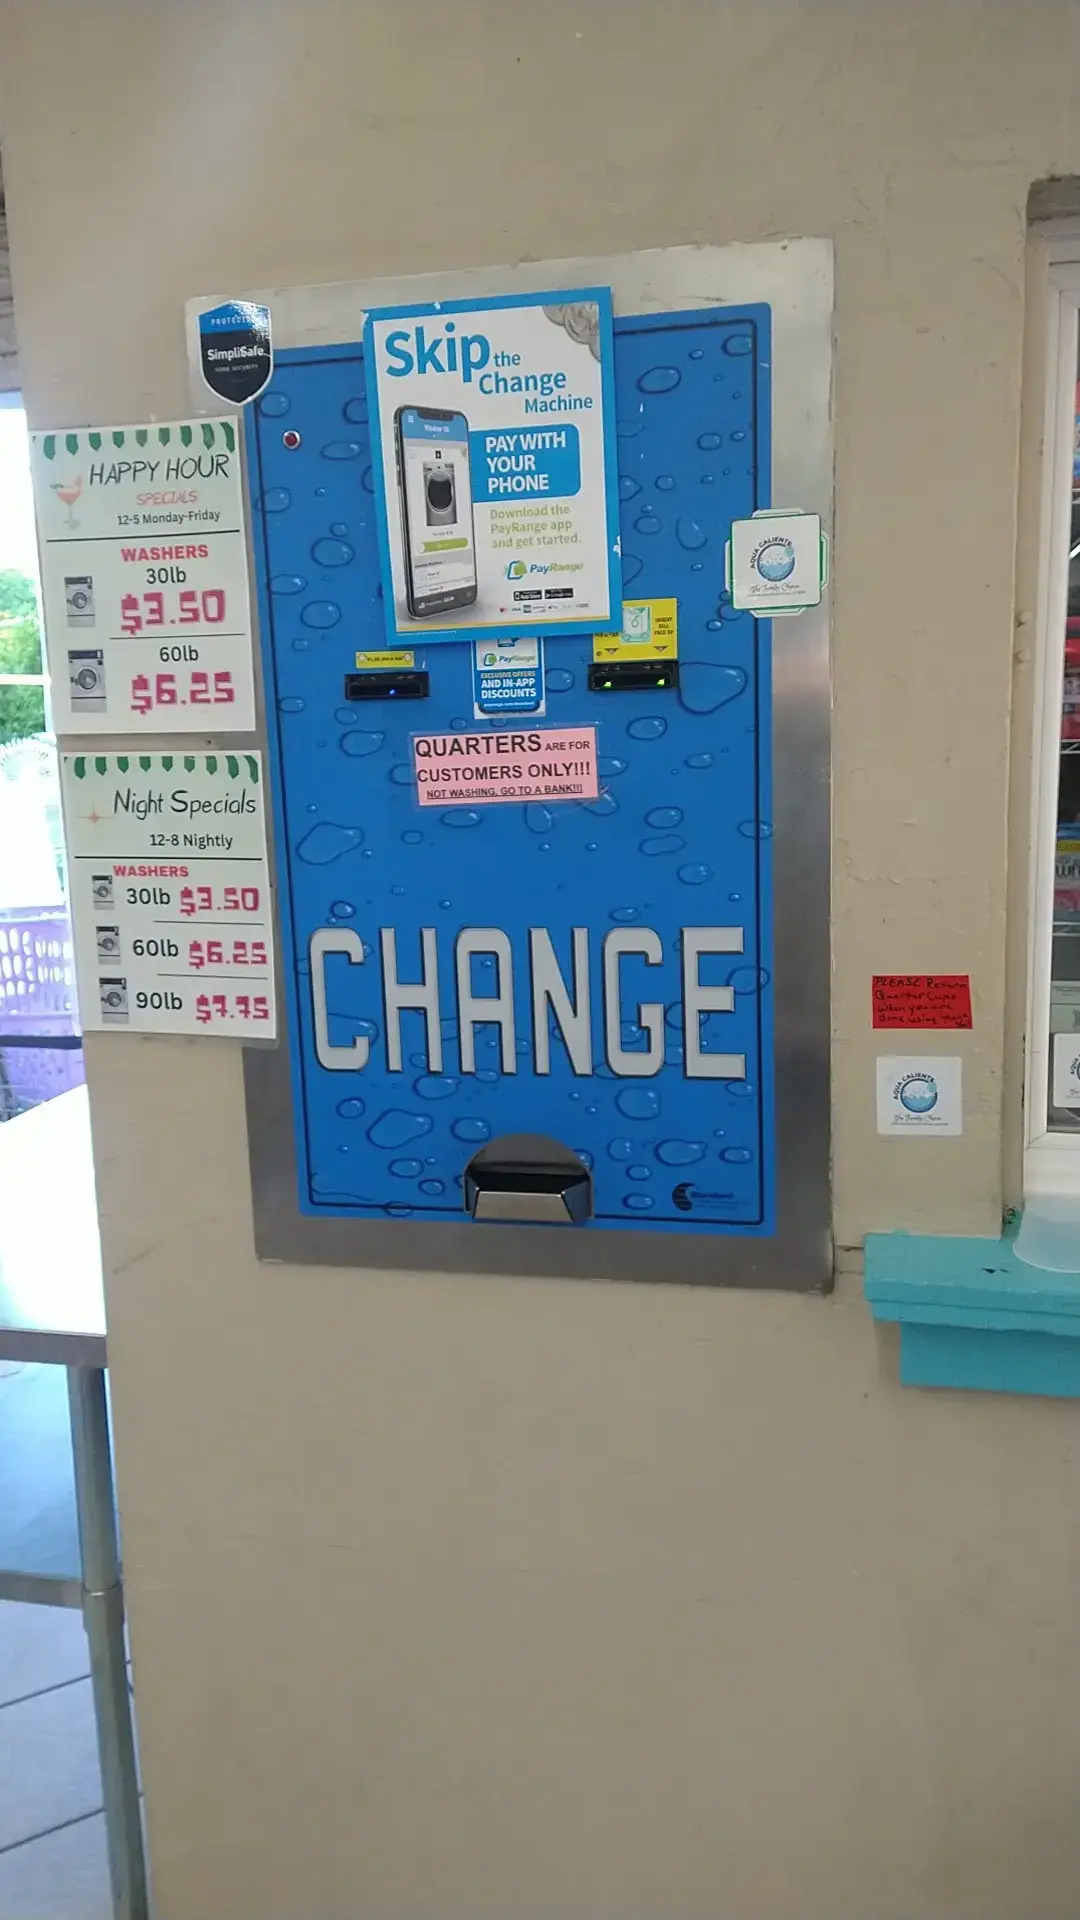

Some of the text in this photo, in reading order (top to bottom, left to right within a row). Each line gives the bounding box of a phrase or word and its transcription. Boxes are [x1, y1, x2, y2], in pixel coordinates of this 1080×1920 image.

[207, 345, 264, 361] SimpliSafe
[384, 322, 521, 383] Skip the
[479, 372, 566, 397] Change
[524, 395, 593, 414] Machine
[485, 431, 566, 453] PAY WITH
[89, 454, 230, 486] HAPPY HOUR
[485, 455, 536, 474] YOUR
[488, 474, 549, 494] PHONE
[136, 490, 198, 506] SPECIALS
[117, 510, 220, 525] 12-5 Monday-Friday
[490, 504, 570, 520] Download the
[490, 520, 572, 535] PayRange app
[492, 532, 582, 550] and get started.
[121, 544, 209, 562] WASHERS
[749, 536, 793, 569] AQUA CALIENTE
[146, 566, 187, 585] 30lb
[529, 562, 584, 575] PayRange
[121, 589, 227, 635] $3.50
[159, 645, 199, 663] 60lb
[481, 678, 535, 688] AND IN-APP
[131, 671, 235, 715] $6.25
[481, 688, 536, 699] DISCOUNTS
[415, 734, 591, 758] QUARTERS ARE FOR
[417, 762, 591, 783] CUSTOMERS ONLY!!!
[427, 783, 583, 799] NOT WASHING, GO TO A BANK!!!
[114, 788, 256, 820] Night Specials
[150, 834, 233, 850] 12-8 Nightly
[113, 865, 189, 878] WASHERS
[126, 886, 260, 917] 30lb $3.50
[132, 940, 268, 970] 60lb $6.25
[876, 976, 921, 988] PLEASE
[136, 992, 269, 1024] 90lb $7.75
[308, 926, 746, 1080] CHANGE
[893, 1072, 935, 1100] AQUA CALIENTE
